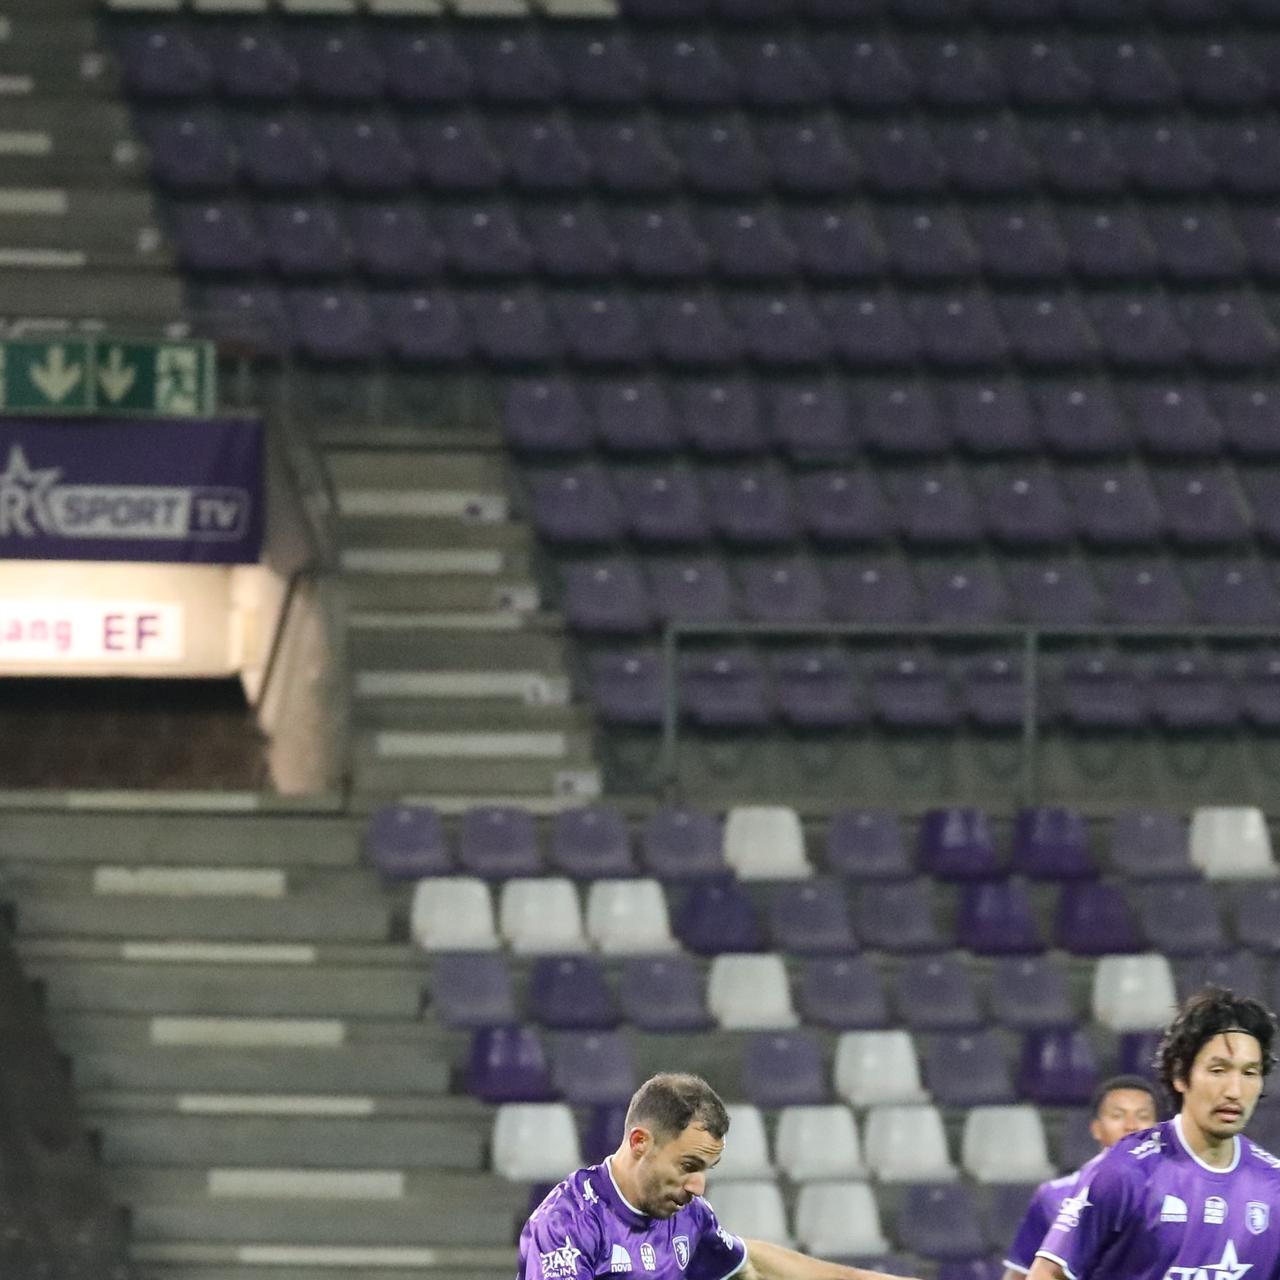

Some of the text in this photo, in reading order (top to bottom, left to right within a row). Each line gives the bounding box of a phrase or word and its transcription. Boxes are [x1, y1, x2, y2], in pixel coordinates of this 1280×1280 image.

[63, 496, 182, 533] SPORT
[195, 500, 237, 530] TV
[103, 614, 160, 650] EF
